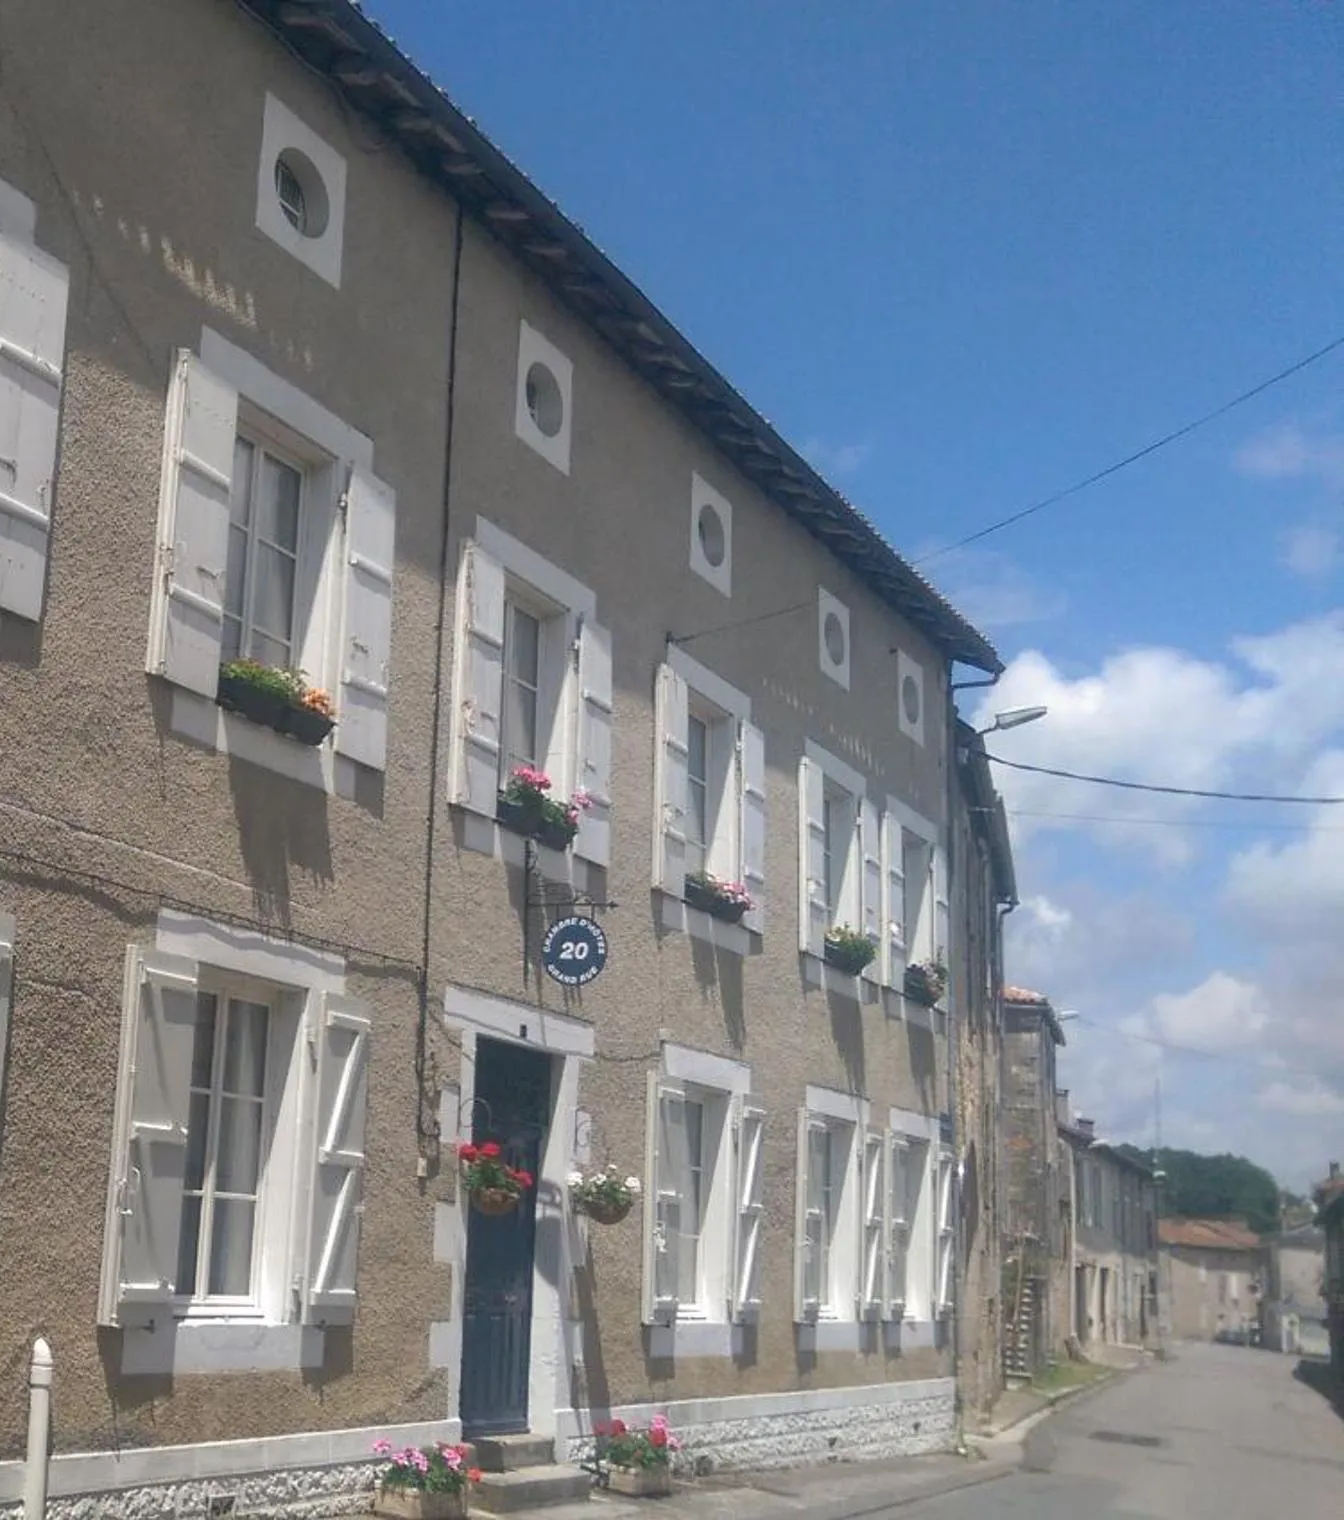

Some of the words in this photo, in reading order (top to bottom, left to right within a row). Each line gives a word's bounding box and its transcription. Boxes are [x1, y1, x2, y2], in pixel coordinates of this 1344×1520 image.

[543, 917, 578, 952] CHAMBRE
[560, 942, 588, 960] 20
[548, 964, 577, 983] GRAND
[580, 966, 599, 982] RUE
